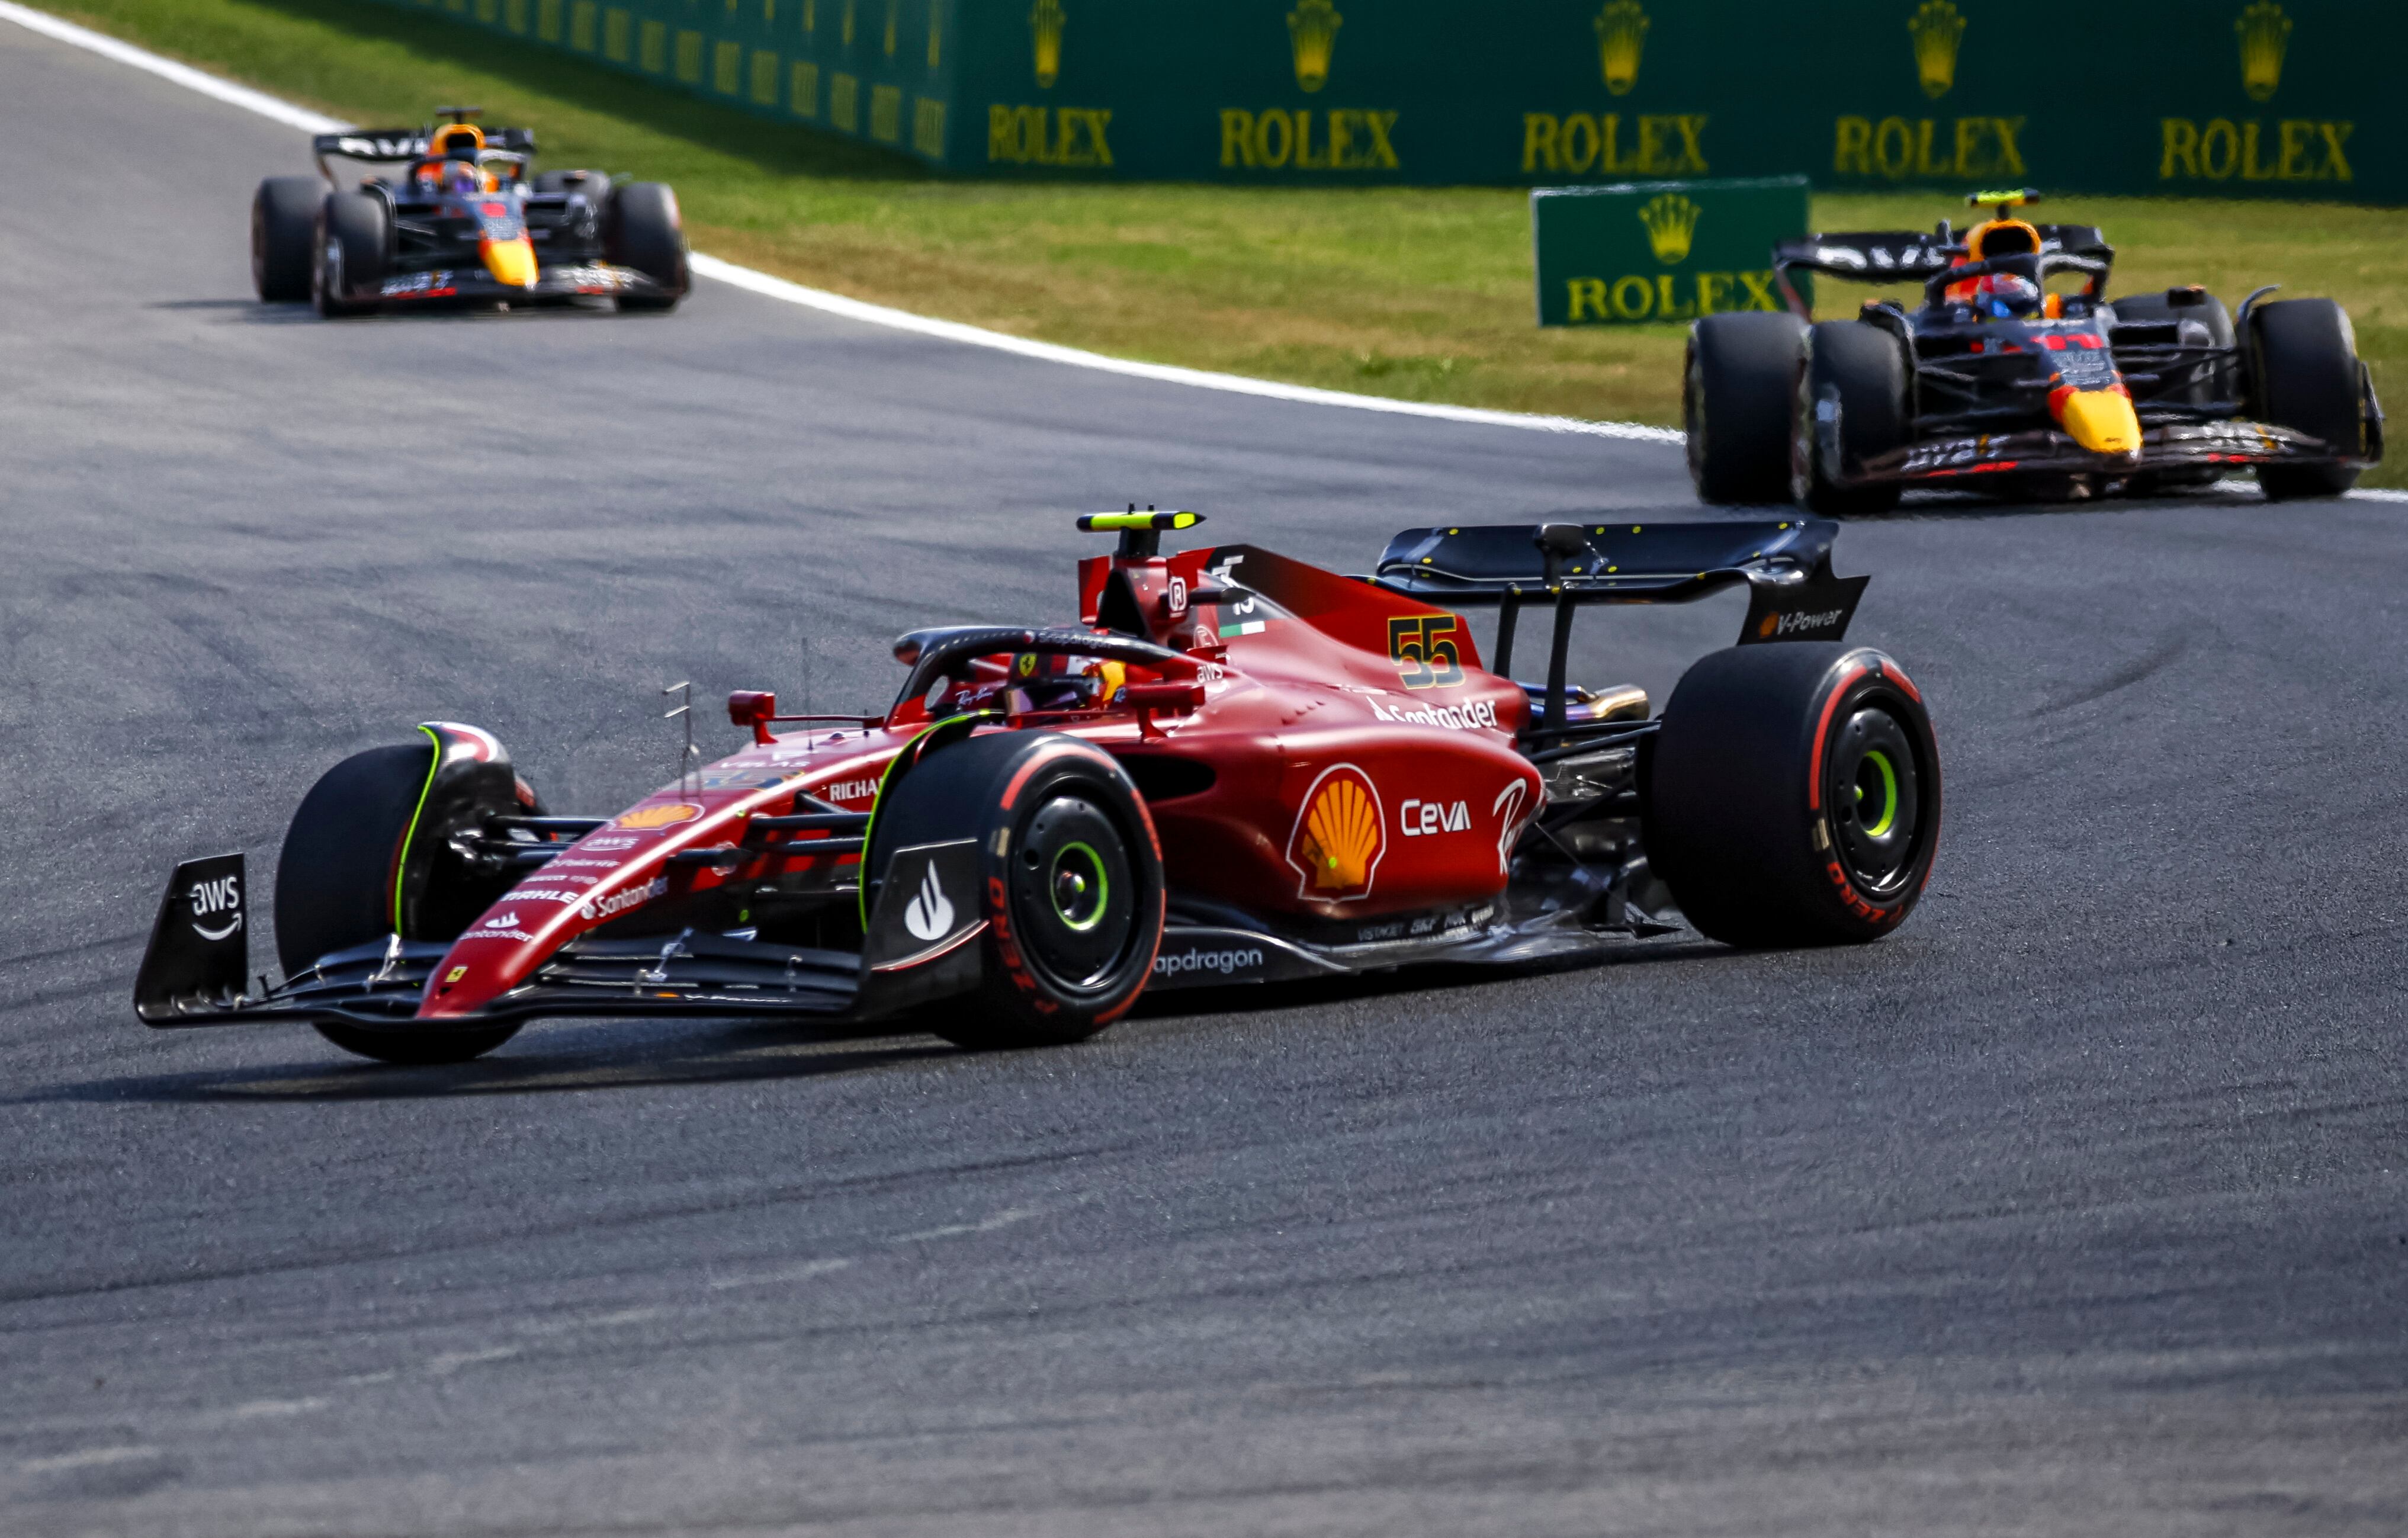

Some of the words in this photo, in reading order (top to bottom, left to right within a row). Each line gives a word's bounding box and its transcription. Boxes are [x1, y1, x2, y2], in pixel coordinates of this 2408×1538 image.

[987, 103, 1114, 167] ROLEX
[1219, 108, 1399, 170] ROLEX
[1520, 111, 1710, 175] ROLEX
[1834, 117, 2028, 177] ROLEX
[2159, 119, 2355, 181] ROLEX
[1566, 271, 1777, 322] ROLEX
[1388, 612, 1466, 689] 55
[1777, 609, 1842, 635] V-Power
[191, 876, 240, 916] aws
[1153, 947, 1263, 978] apdragon
